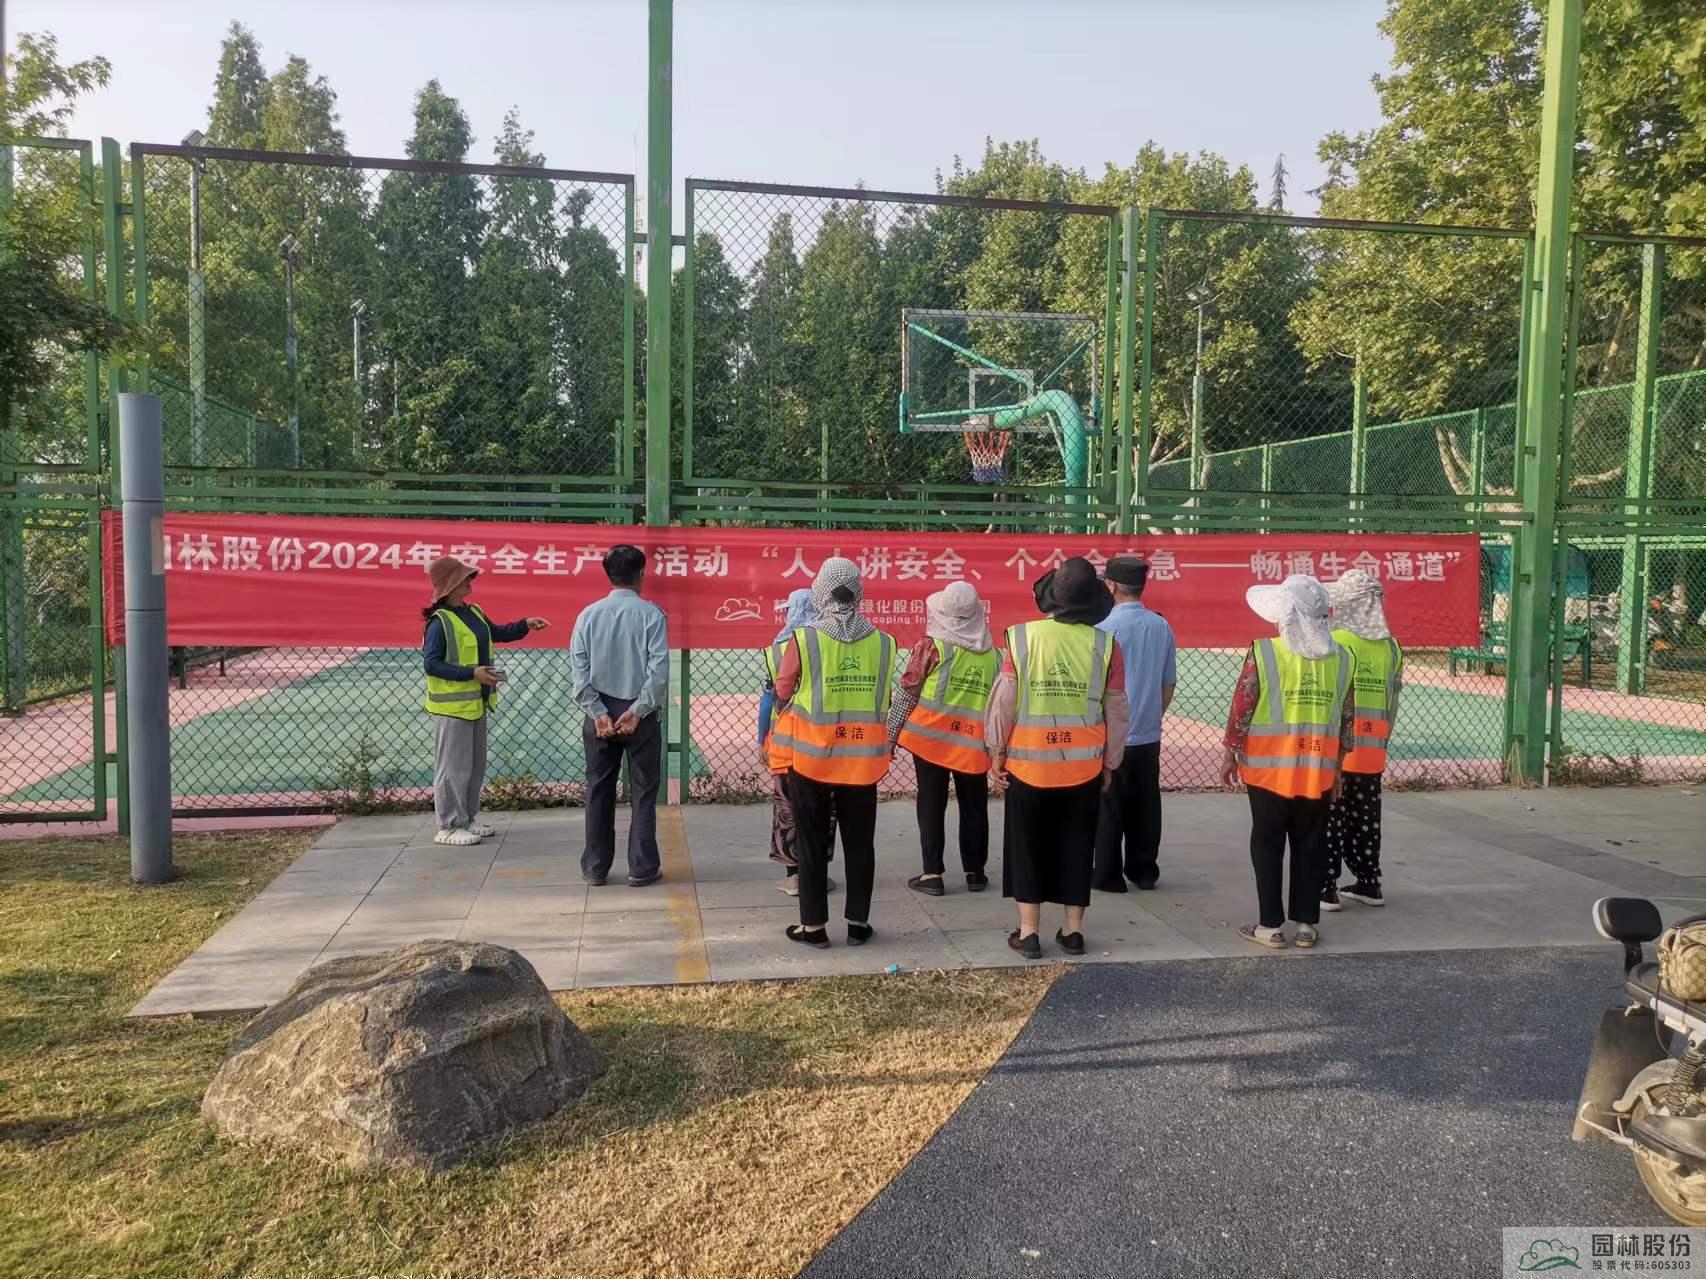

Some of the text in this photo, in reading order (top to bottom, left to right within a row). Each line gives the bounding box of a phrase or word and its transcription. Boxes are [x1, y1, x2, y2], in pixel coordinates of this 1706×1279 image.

[163, 533, 728, 577] 林股份2024年安全生产活动
[836, 726, 864, 739] 保洁
[1046, 731, 1072, 744] 保洁
